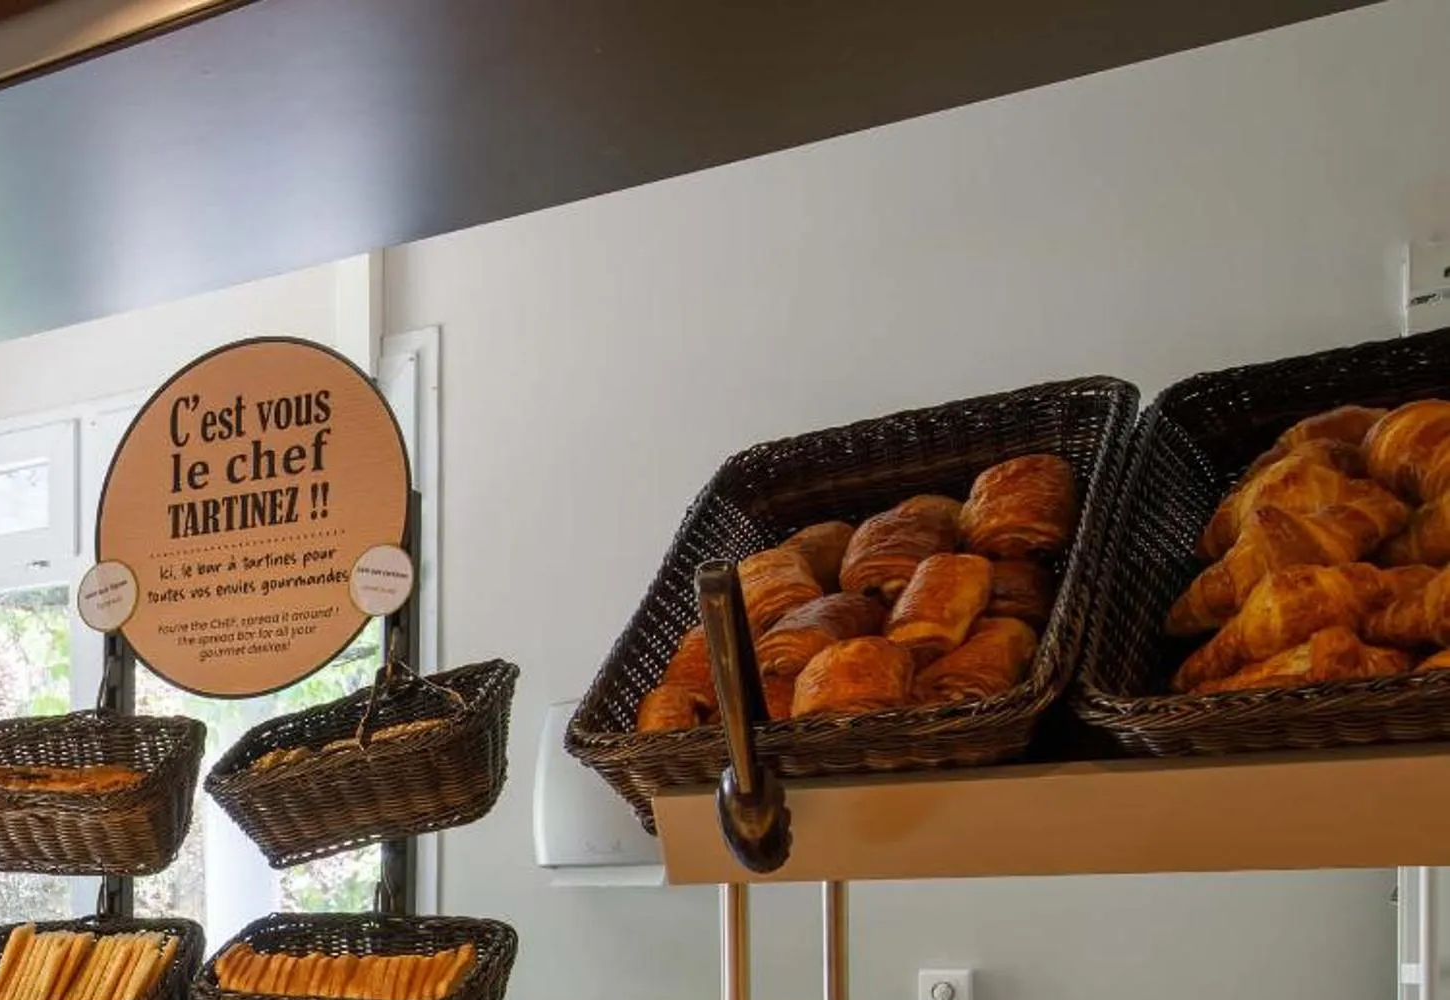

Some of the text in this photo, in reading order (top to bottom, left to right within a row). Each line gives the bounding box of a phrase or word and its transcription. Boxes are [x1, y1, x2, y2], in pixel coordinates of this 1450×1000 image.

[170, 390, 331, 447] C'est vous
[171, 427, 331, 493] le chef
[168, 487, 299, 539] TARTINEZ
[147, 589, 185, 604] toutes
[190, 588, 211, 599] vos
[216, 581, 255, 597] envies
[261, 568, 350, 596] gourmandes
[197, 562, 221, 575] bar
[243, 553, 296, 570] tartines
[302, 548, 337, 567] pour
